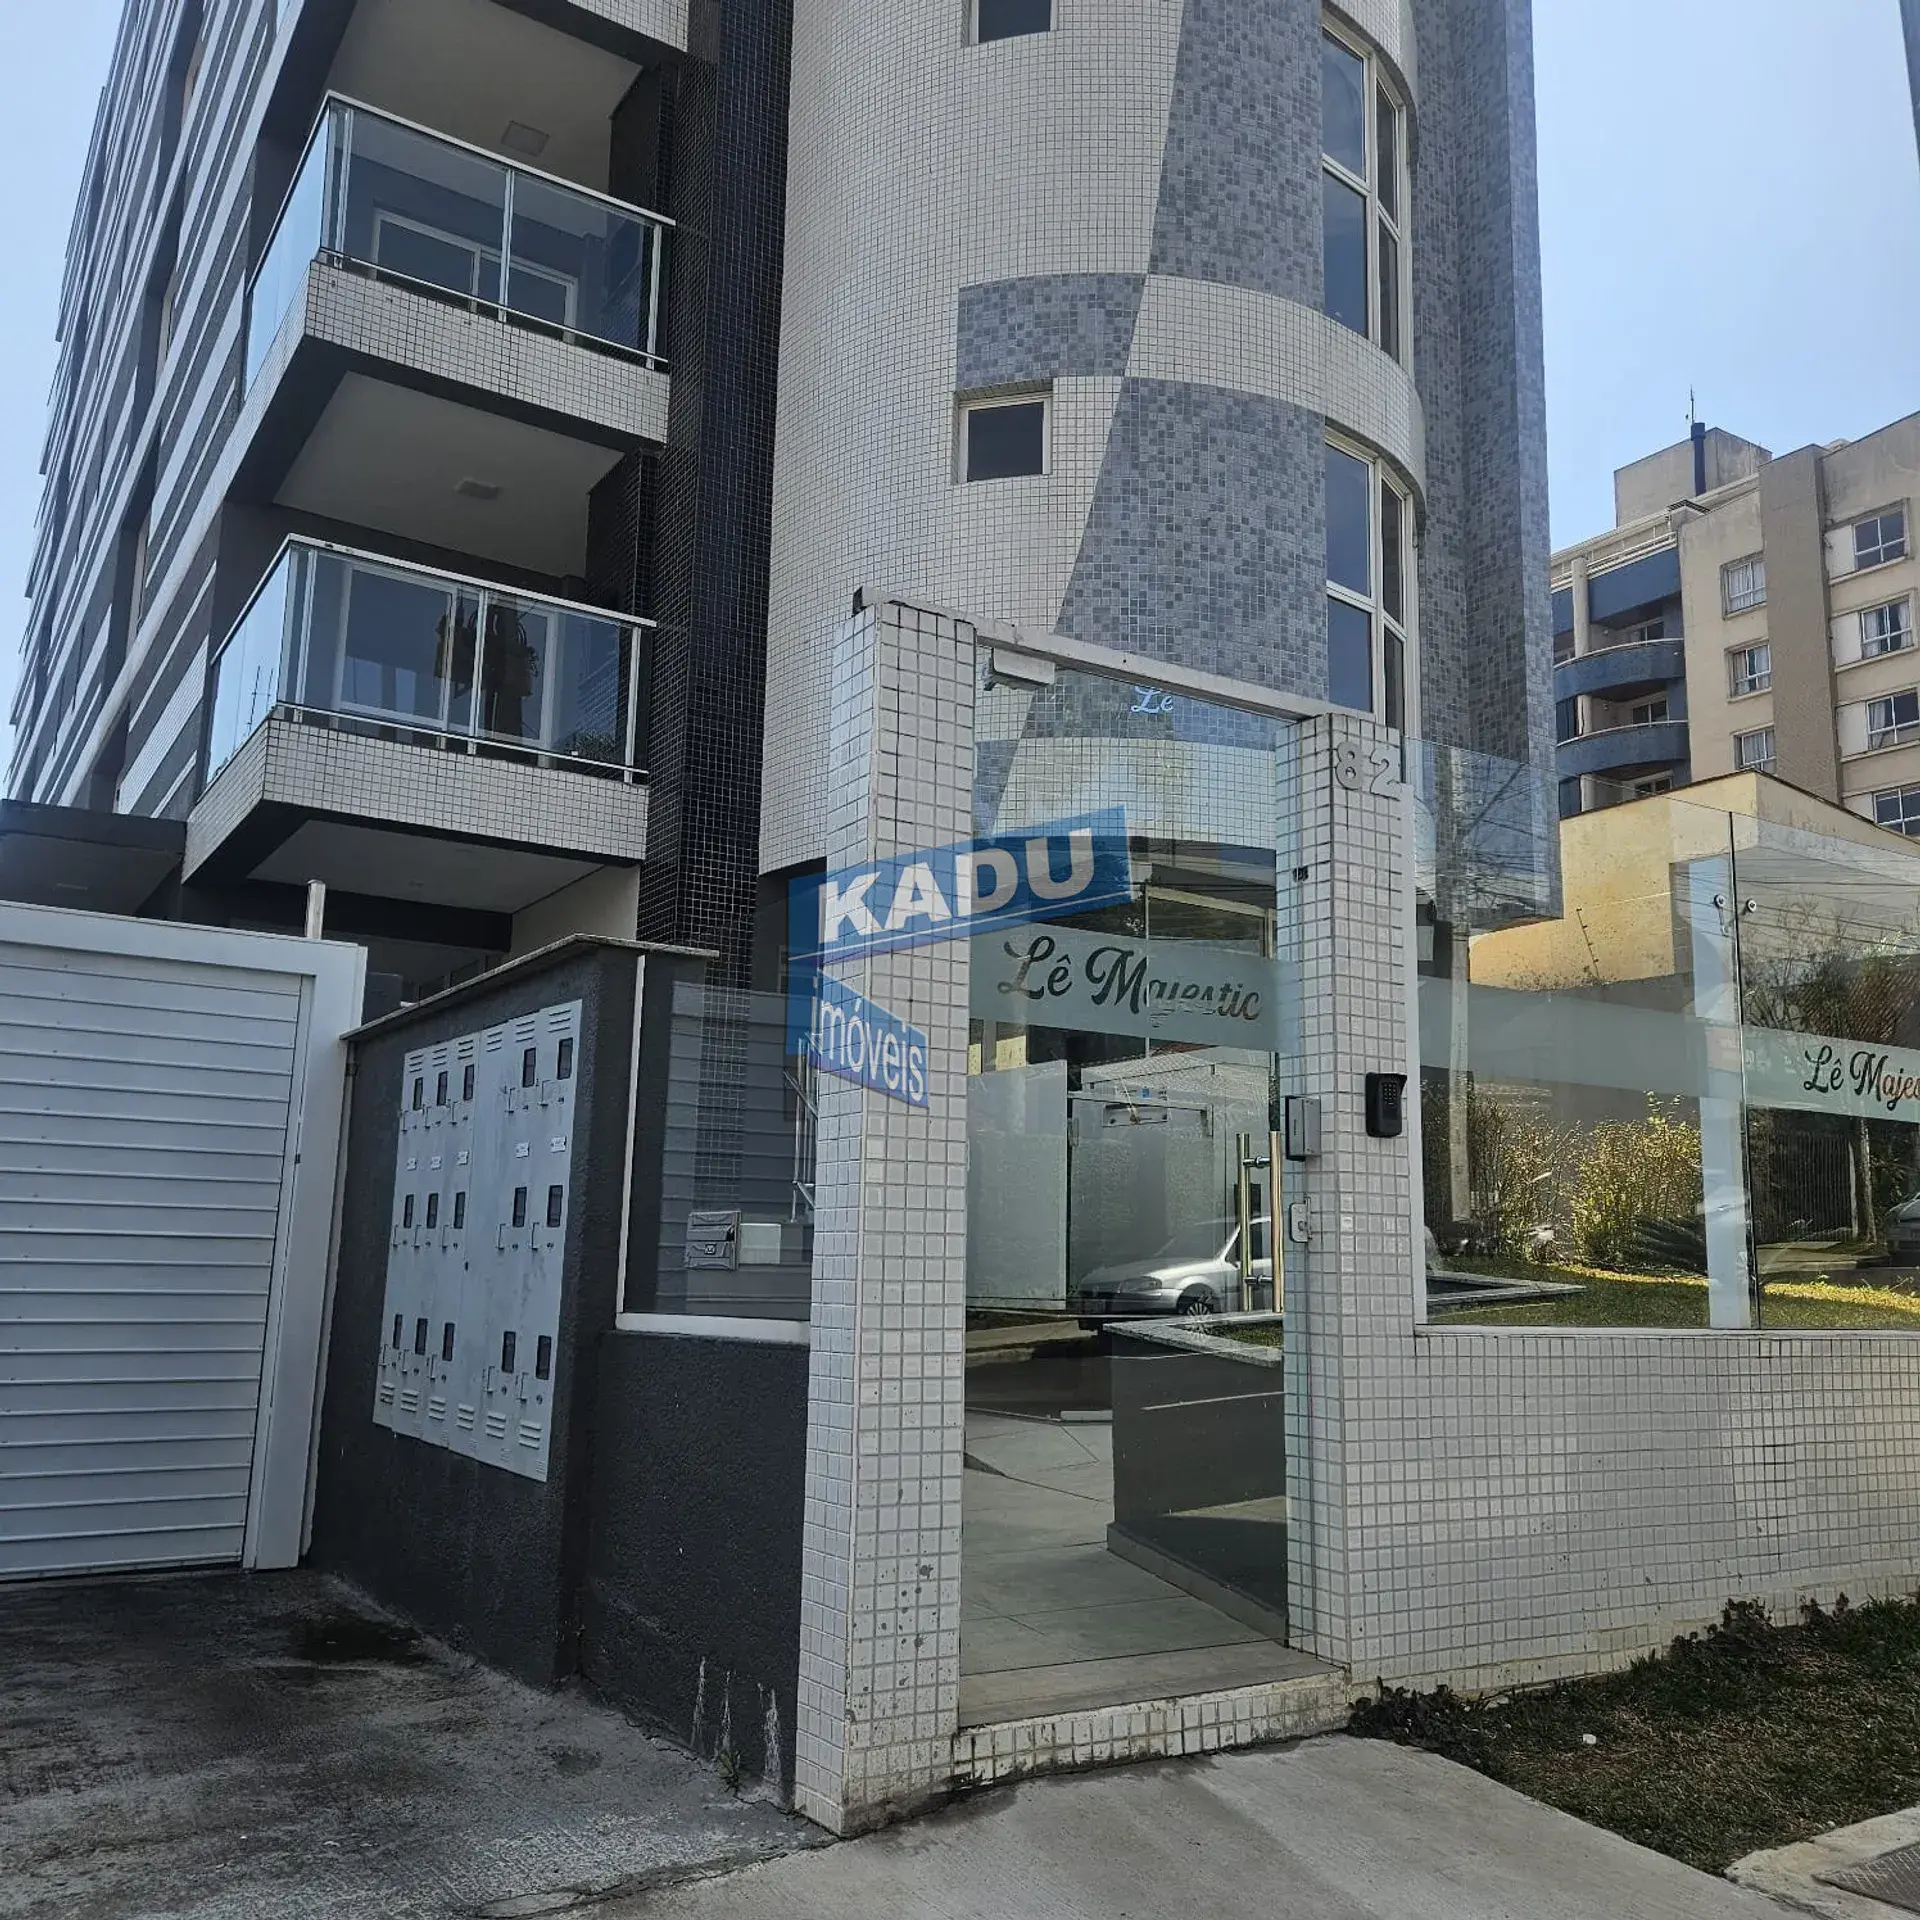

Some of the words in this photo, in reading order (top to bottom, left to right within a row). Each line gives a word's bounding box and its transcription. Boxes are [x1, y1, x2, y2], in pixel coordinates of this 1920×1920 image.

[1335, 741, 1403, 801] 82
[997, 936, 1073, 1000] Lê
[1803, 1045, 1844, 1093] Lê
